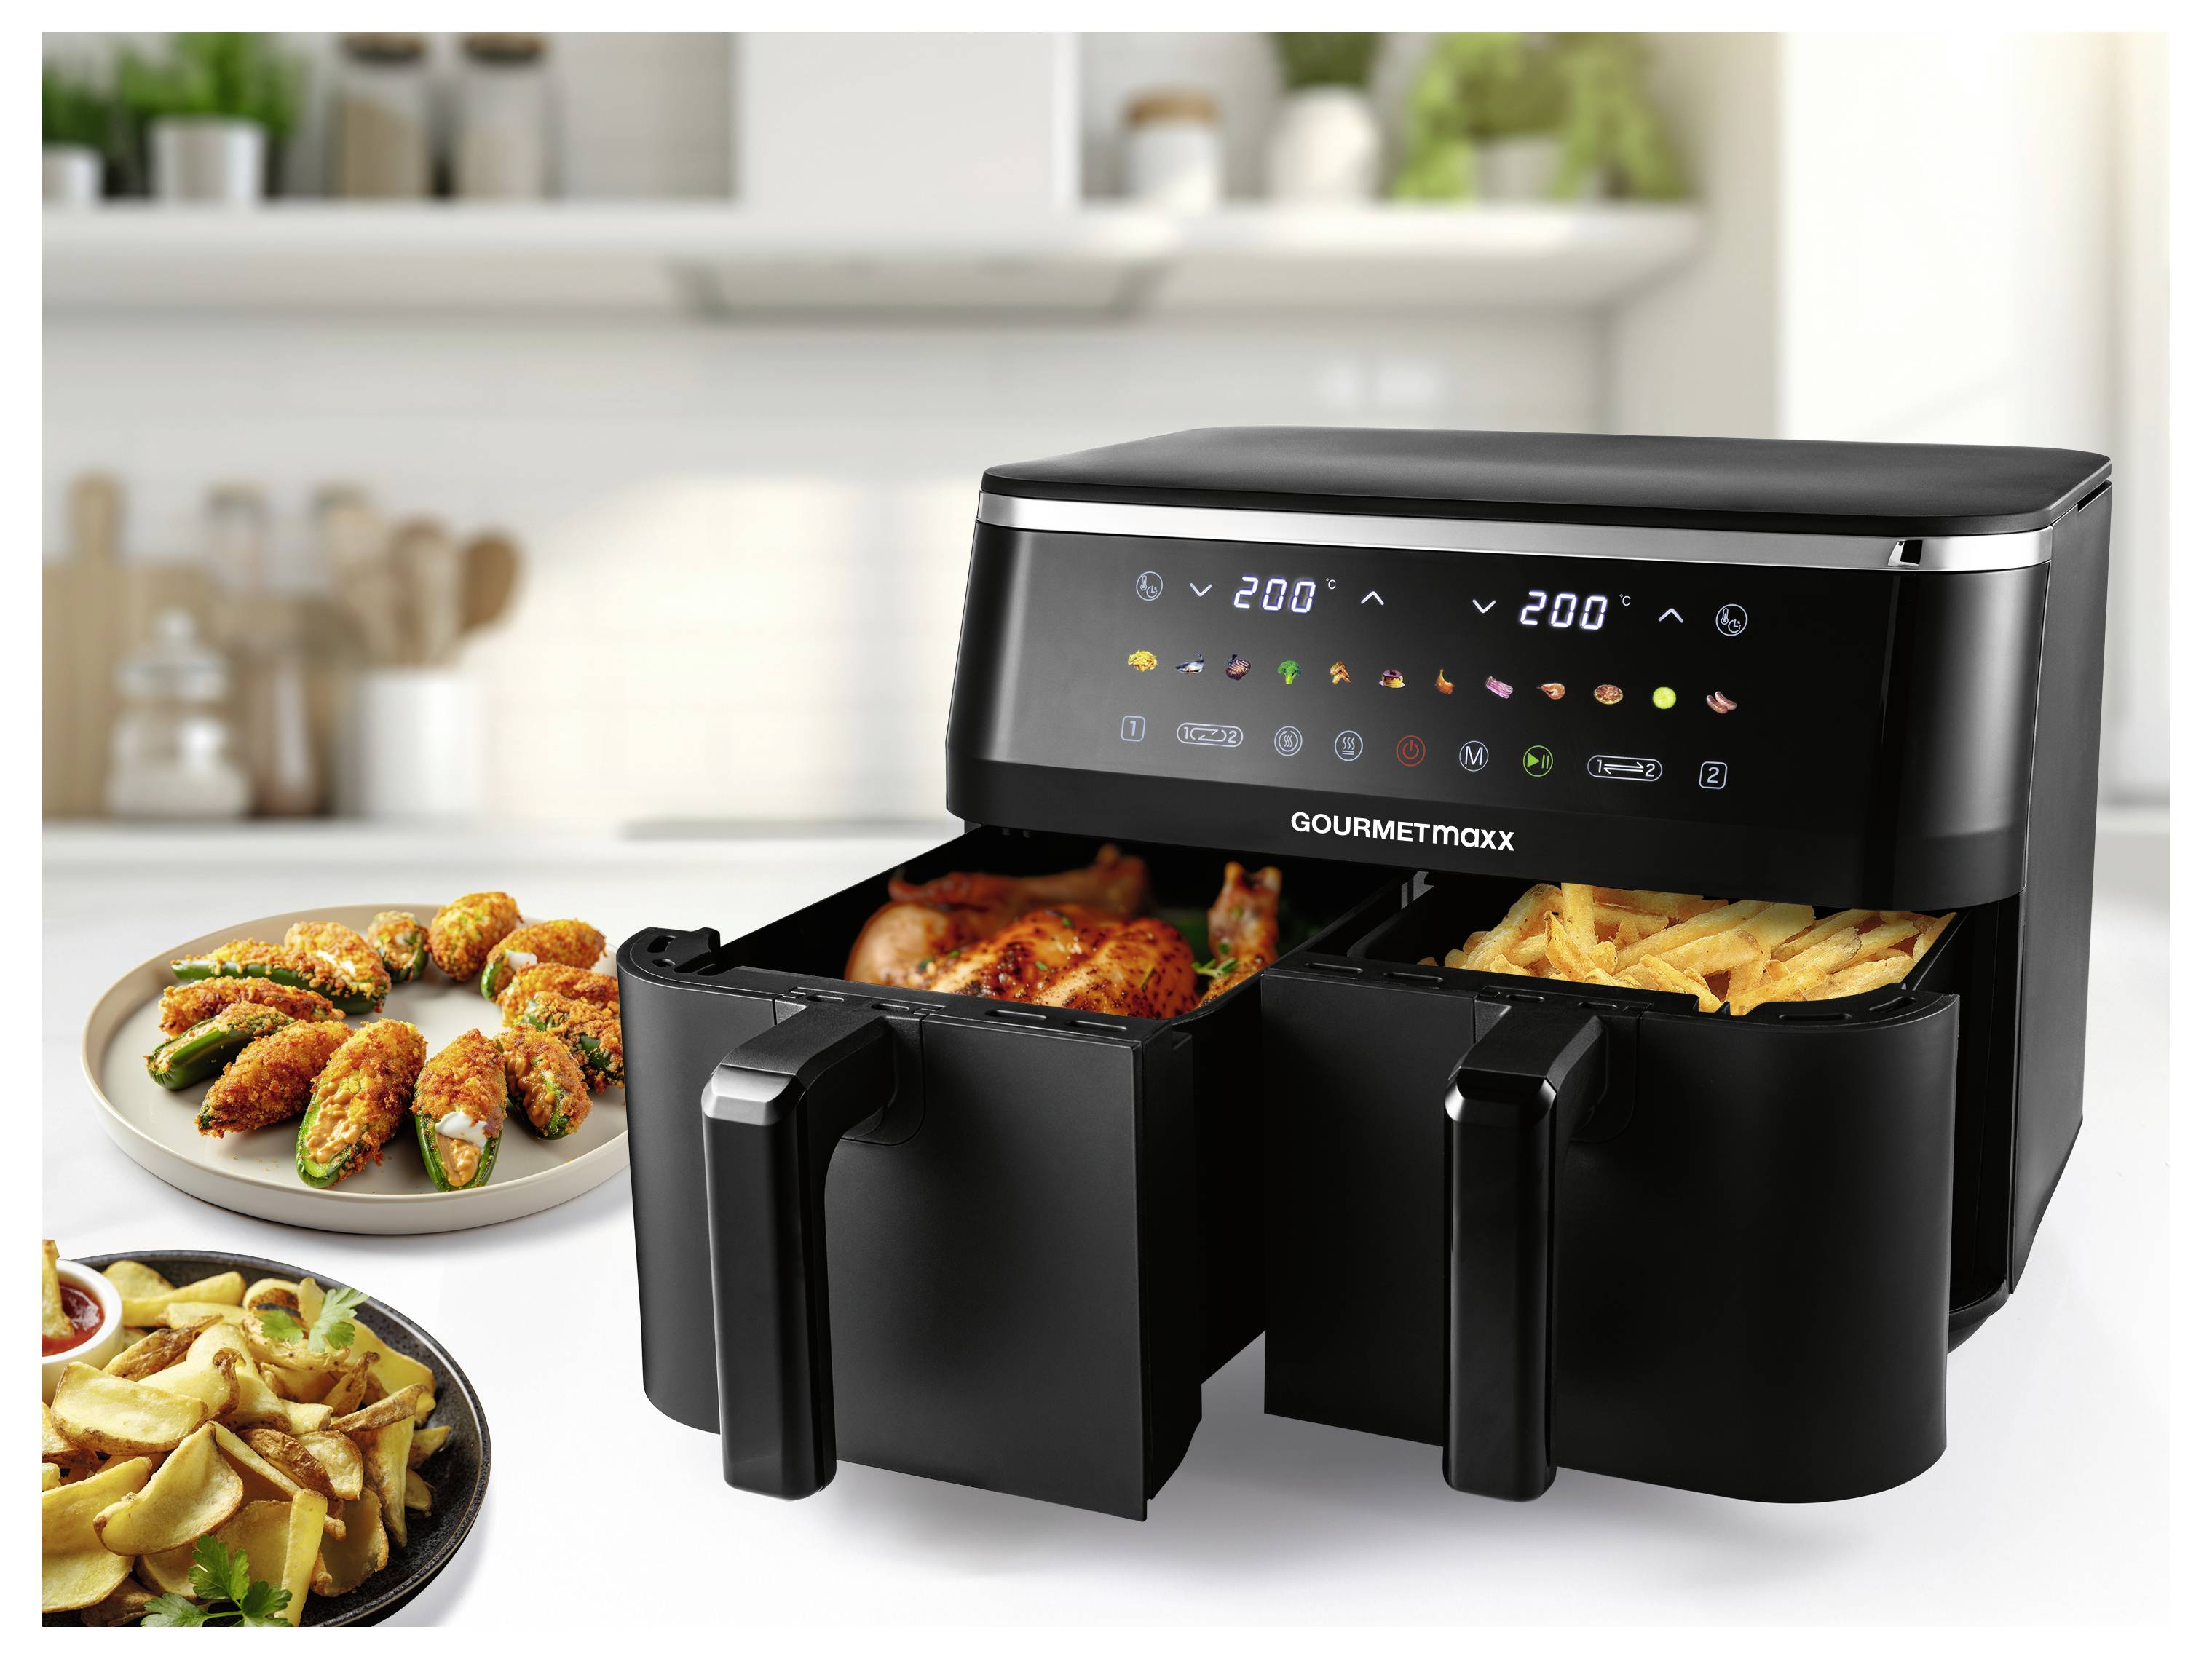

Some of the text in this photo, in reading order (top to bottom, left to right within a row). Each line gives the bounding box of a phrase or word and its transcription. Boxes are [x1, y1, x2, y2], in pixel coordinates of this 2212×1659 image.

[1233, 574, 1317, 614] 200
[1520, 589, 1608, 631] 200
[1130, 720, 1137, 736] 1
[1465, 746, 1483, 766] M
[1707, 767, 1719, 784] 2
[1291, 812, 1515, 852] GOURMETmaxx
